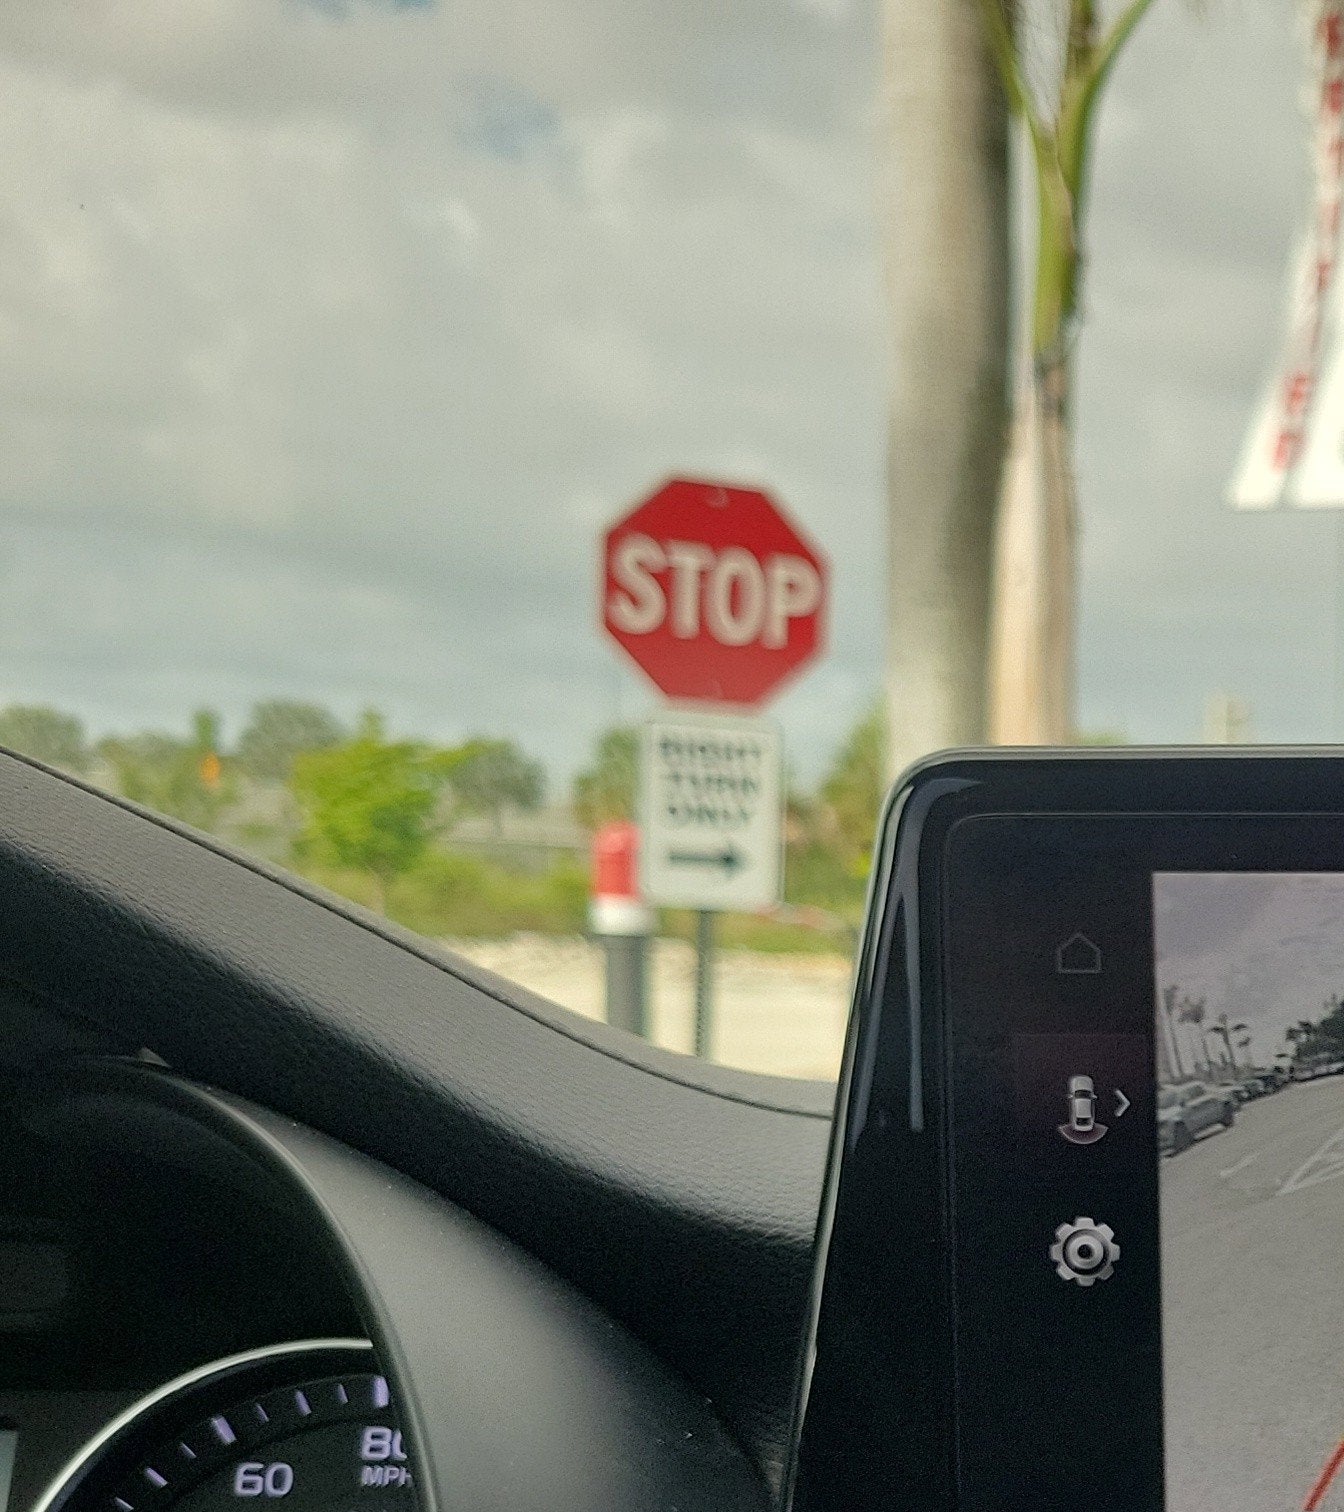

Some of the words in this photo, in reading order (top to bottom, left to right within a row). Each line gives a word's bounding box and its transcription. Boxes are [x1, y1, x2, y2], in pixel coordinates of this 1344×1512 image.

[607, 531, 824, 649] STOP
[658, 737, 762, 762] RIGHT
[666, 802, 751, 827] ONLY
[234, 1462, 295, 1498] 60
